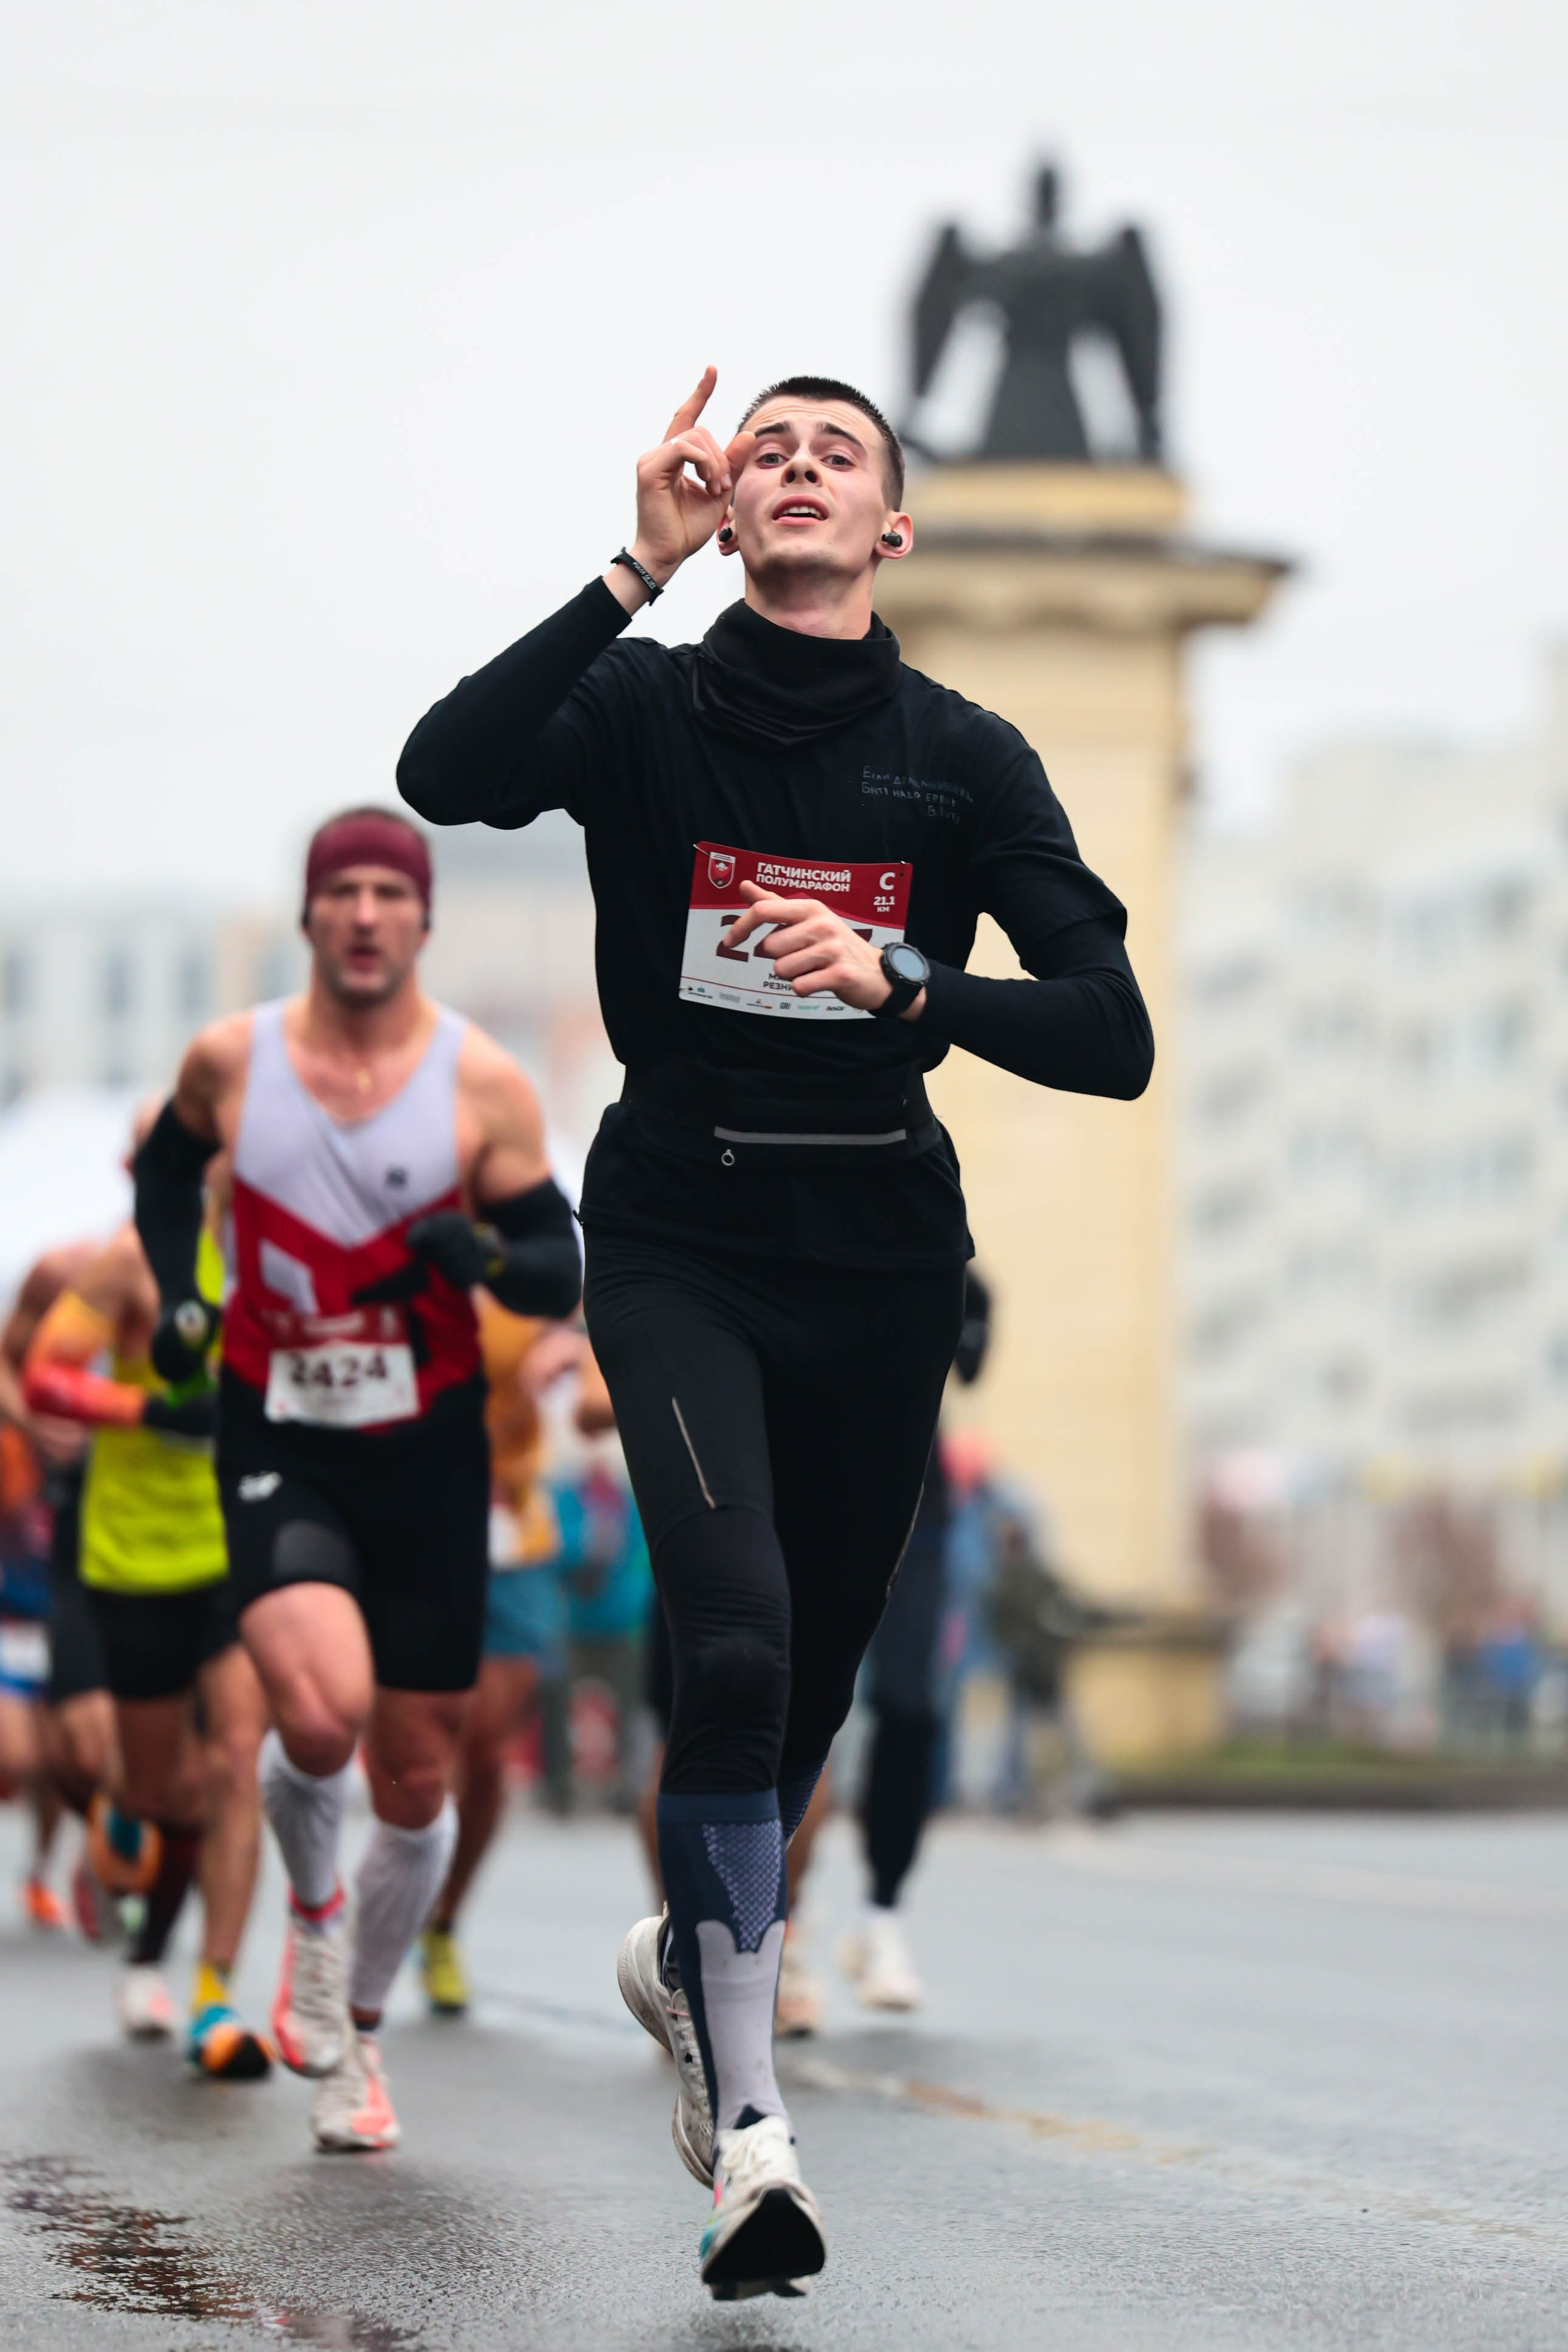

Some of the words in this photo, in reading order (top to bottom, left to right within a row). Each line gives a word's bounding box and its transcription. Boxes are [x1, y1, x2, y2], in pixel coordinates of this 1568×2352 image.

[757, 862, 852, 883] ГАТЧИНСКИЙ
[756, 873, 851, 892] ПОЛУМАРАФОН
[873, 895, 895, 905] 21.1
